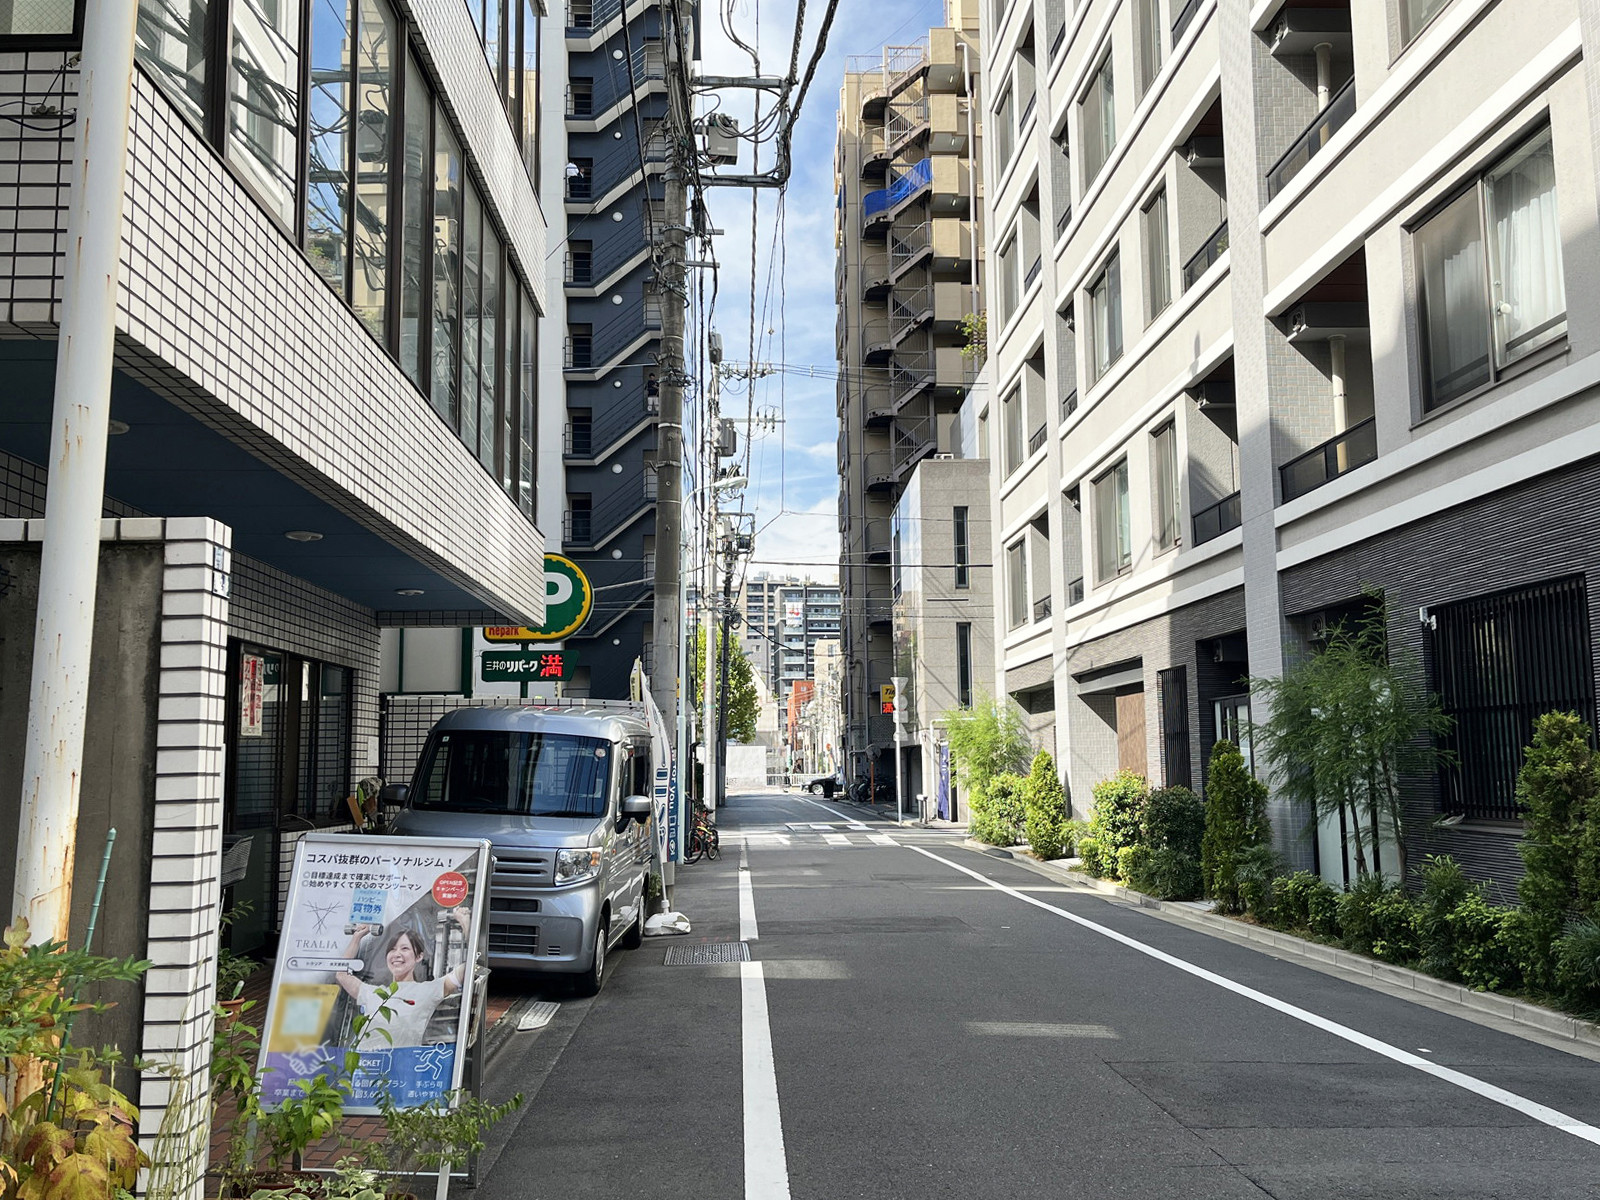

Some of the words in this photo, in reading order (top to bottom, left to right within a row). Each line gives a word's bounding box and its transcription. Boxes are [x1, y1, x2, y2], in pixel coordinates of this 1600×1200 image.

[543, 572, 573, 624] P
[485, 659, 538, 673] 三井のリパーク
[540, 654, 563, 677] 満
[295, 939, 338, 949] TRALIA
[358, 1059, 382, 1067] ICKET
